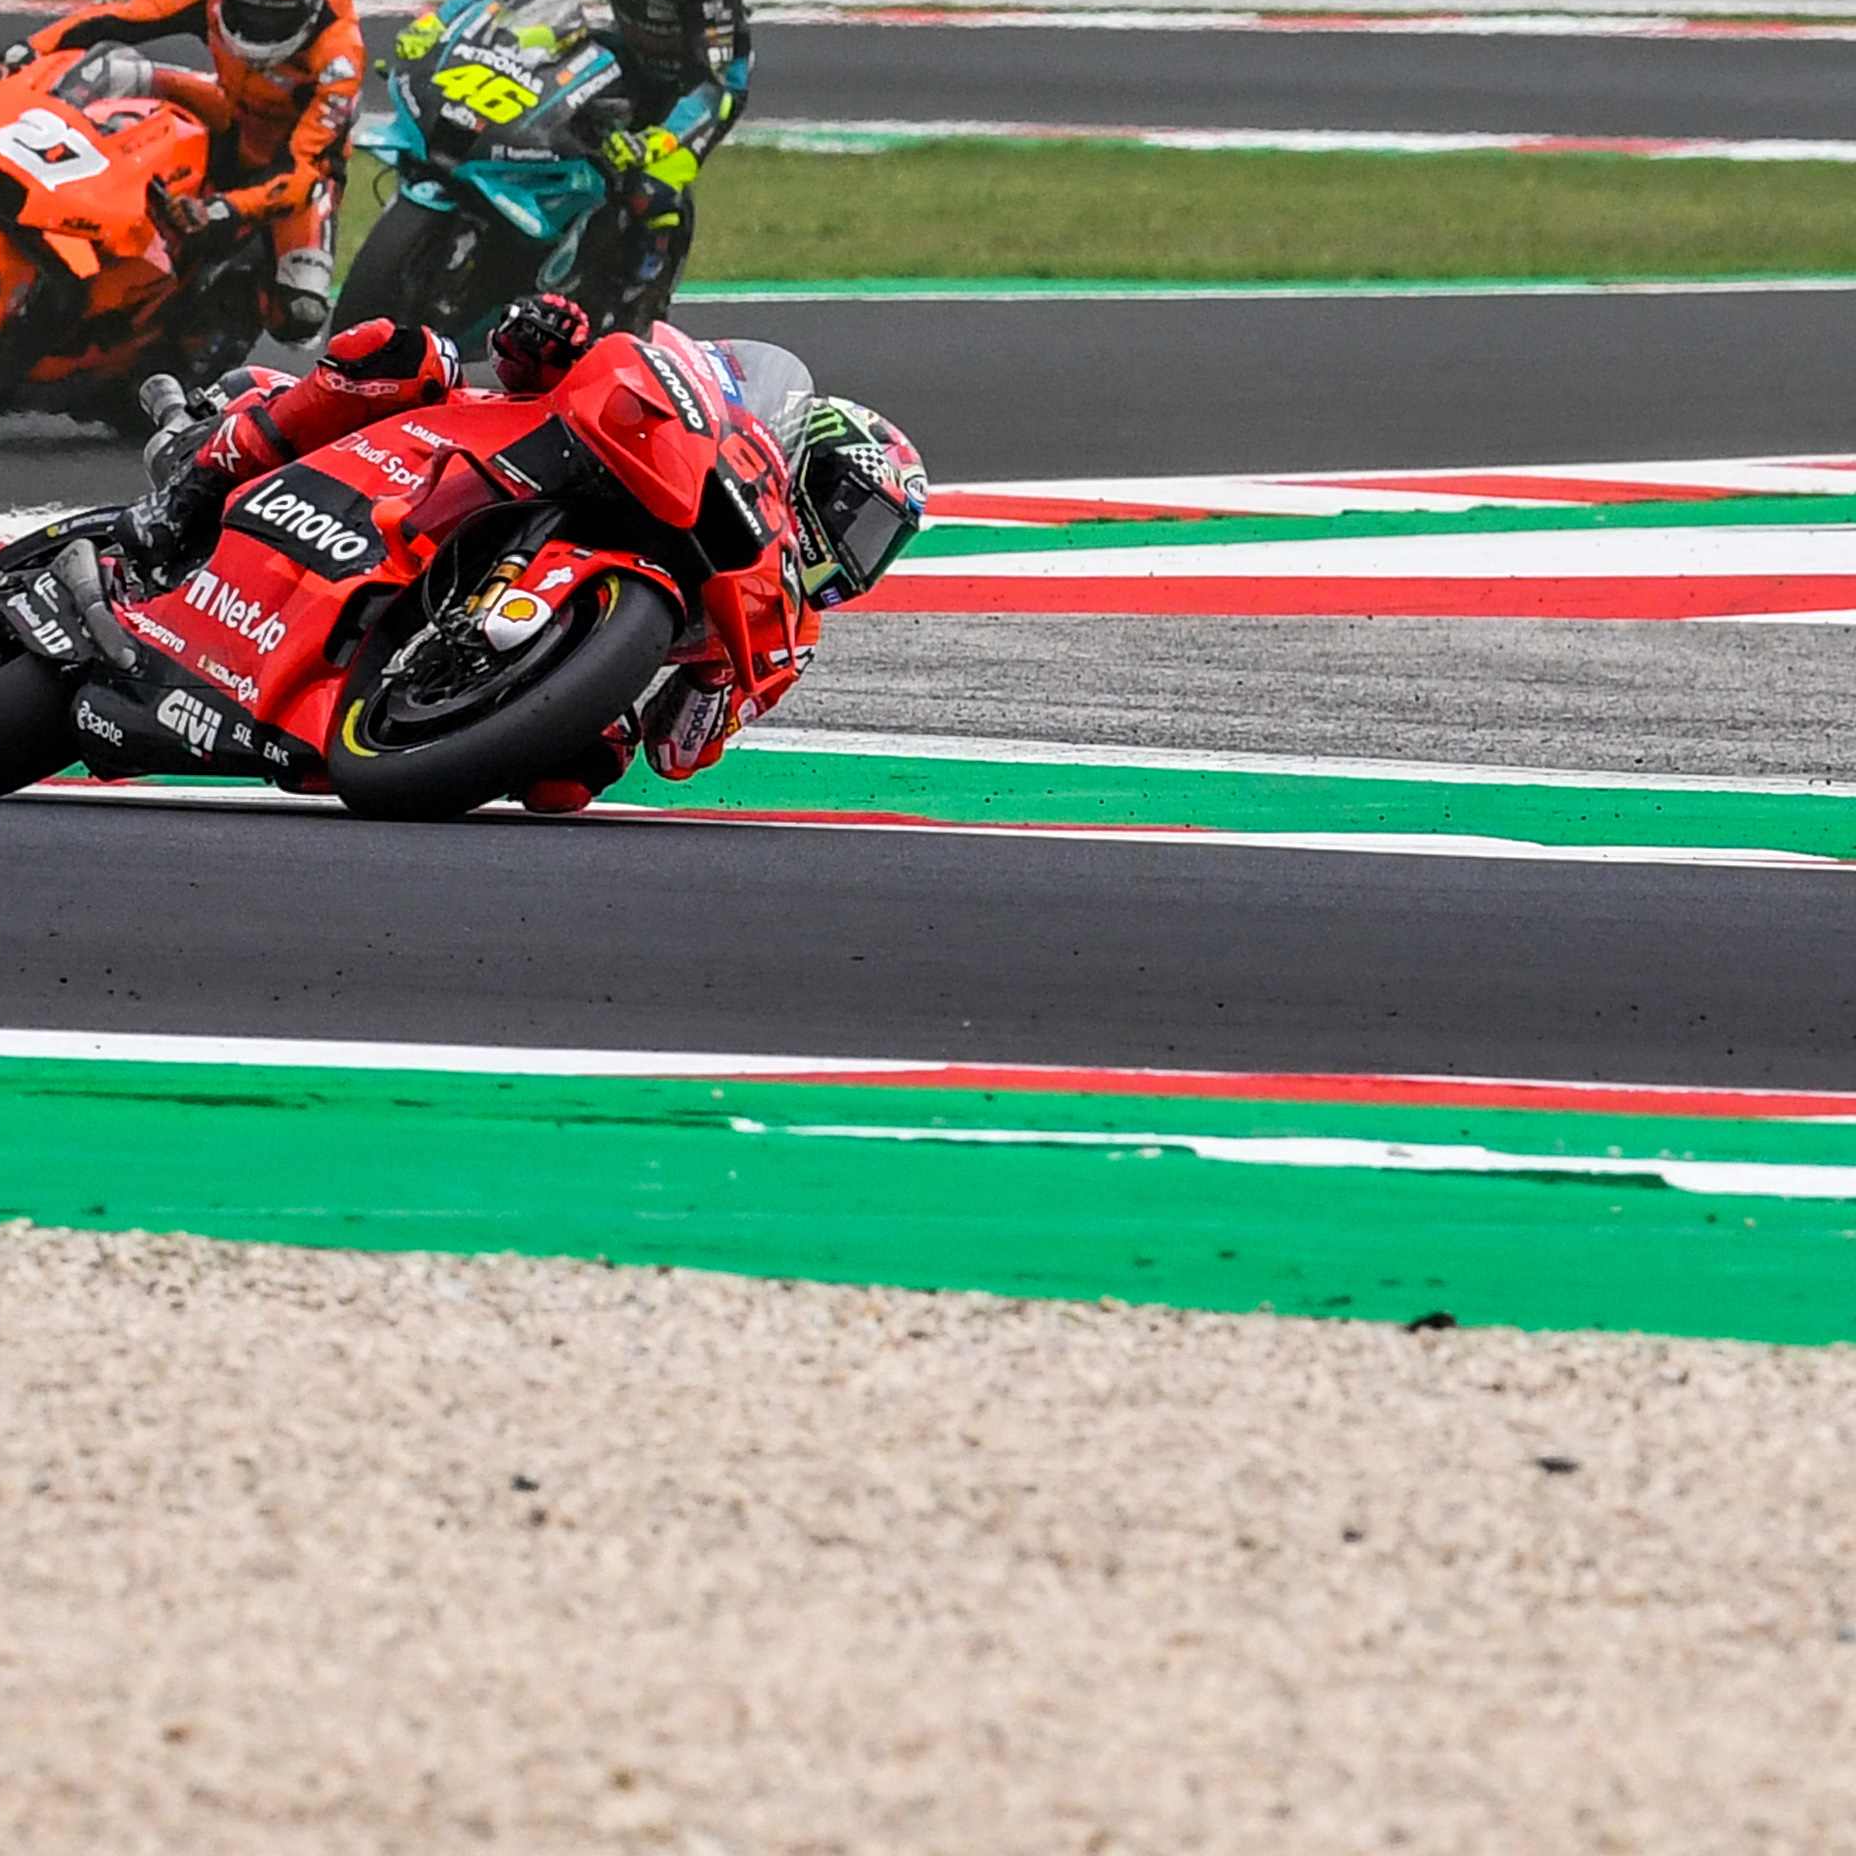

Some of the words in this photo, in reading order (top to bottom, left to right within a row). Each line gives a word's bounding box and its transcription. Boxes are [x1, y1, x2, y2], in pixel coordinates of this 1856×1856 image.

[431, 63, 539, 125] 46
[453, 44, 545, 94] PETRONAS
[643, 346, 704, 430] Lenovo
[352, 439, 393, 466] Audi
[244, 478, 370, 562] Lenovo
[724, 478, 763, 536] DUCATI
[156, 688, 223, 752] GIVI
